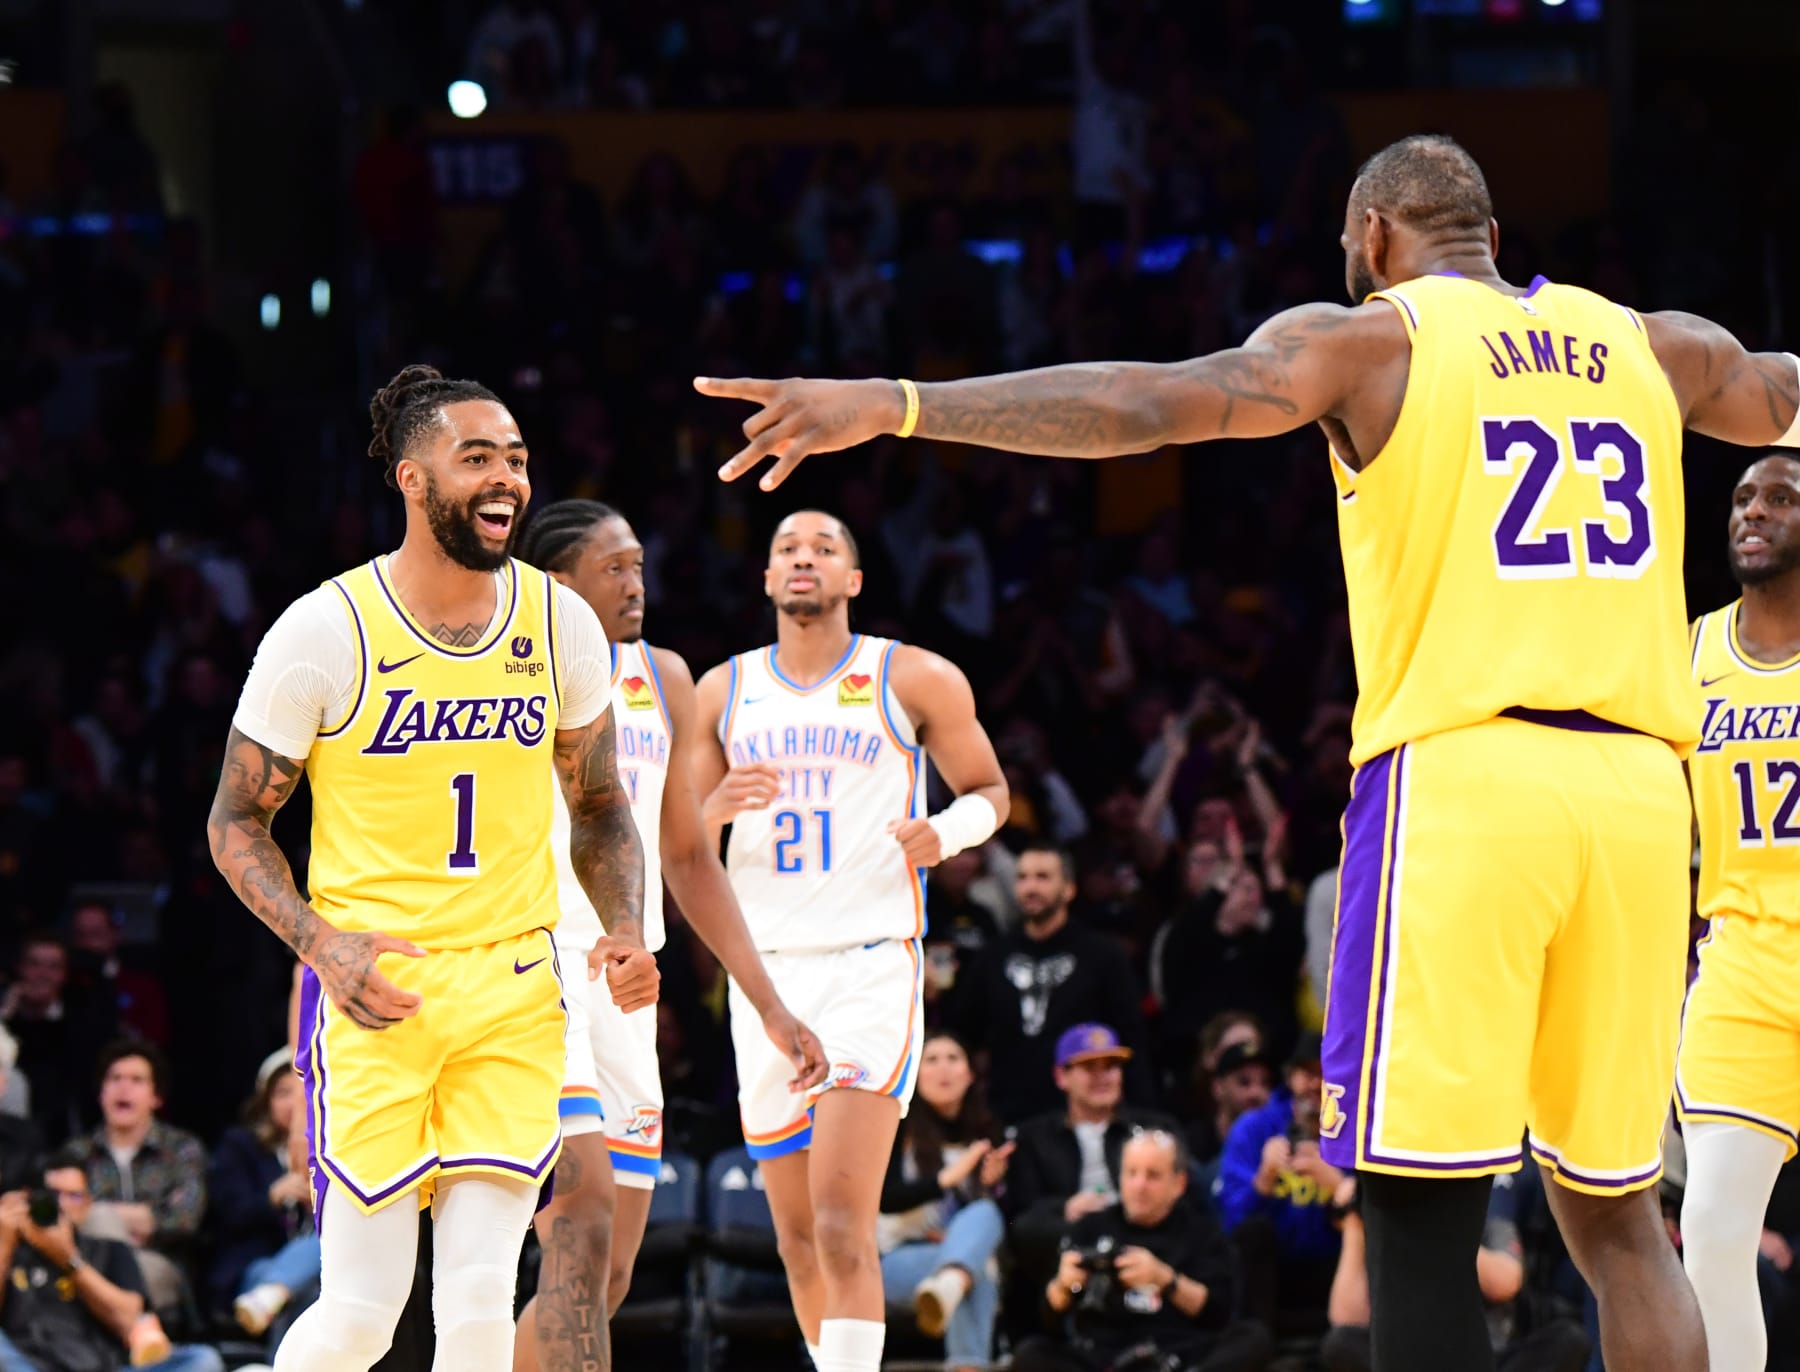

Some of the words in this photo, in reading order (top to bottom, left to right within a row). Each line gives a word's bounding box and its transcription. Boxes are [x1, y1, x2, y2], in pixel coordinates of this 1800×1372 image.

[1481, 330, 1608, 384] JAMES
[1482, 418, 1653, 571] 23
[505, 661, 544, 677] bibigo
[361, 689, 547, 755] LAKERS
[617, 726, 667, 765] OMA
[733, 725, 882, 765] OKLAHOMA
[1697, 698, 1800, 752] LAKE
[447, 772, 478, 870] 1
[1734, 760, 1800, 841] 12
[774, 811, 832, 873] 21
